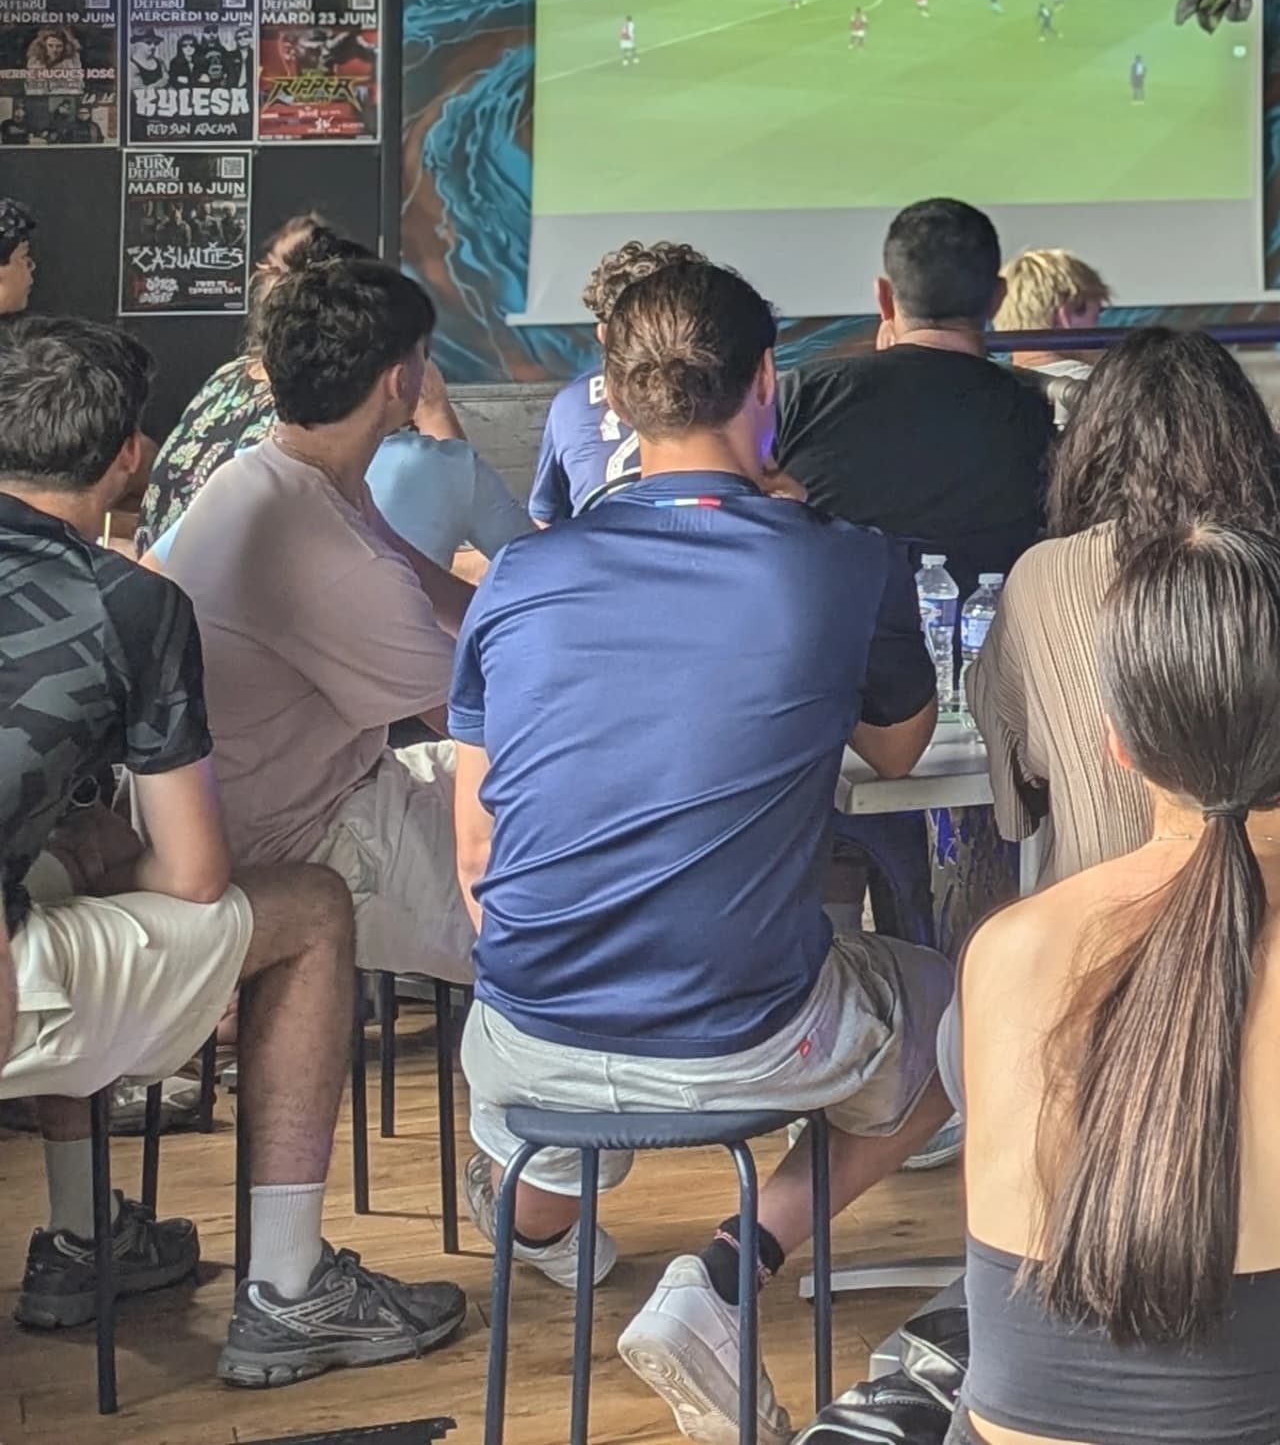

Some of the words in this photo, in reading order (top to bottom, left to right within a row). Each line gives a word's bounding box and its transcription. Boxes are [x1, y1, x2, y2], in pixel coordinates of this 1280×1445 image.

[0, 12, 63, 24] ENDREDI
[67, 12, 79, 23] 19
[82, 12, 115, 24] JUIN
[131, 11, 202, 22] MERCREDI
[205, 11, 219, 22] 10
[221, 11, 253, 22] JUIN
[261, 12, 315, 25] MARDI
[318, 12, 336, 25] 23
[339, 12, 377, 25] JUIN
[133, 87, 250, 117] KYLESA
[146, 123, 168, 136] RED
[169, 122, 191, 135] SUN
[135, 154, 175, 169] FURY
[128, 182, 183, 195] MARDI
[187, 182, 203, 195] 16
[206, 182, 245, 195] JUIN
